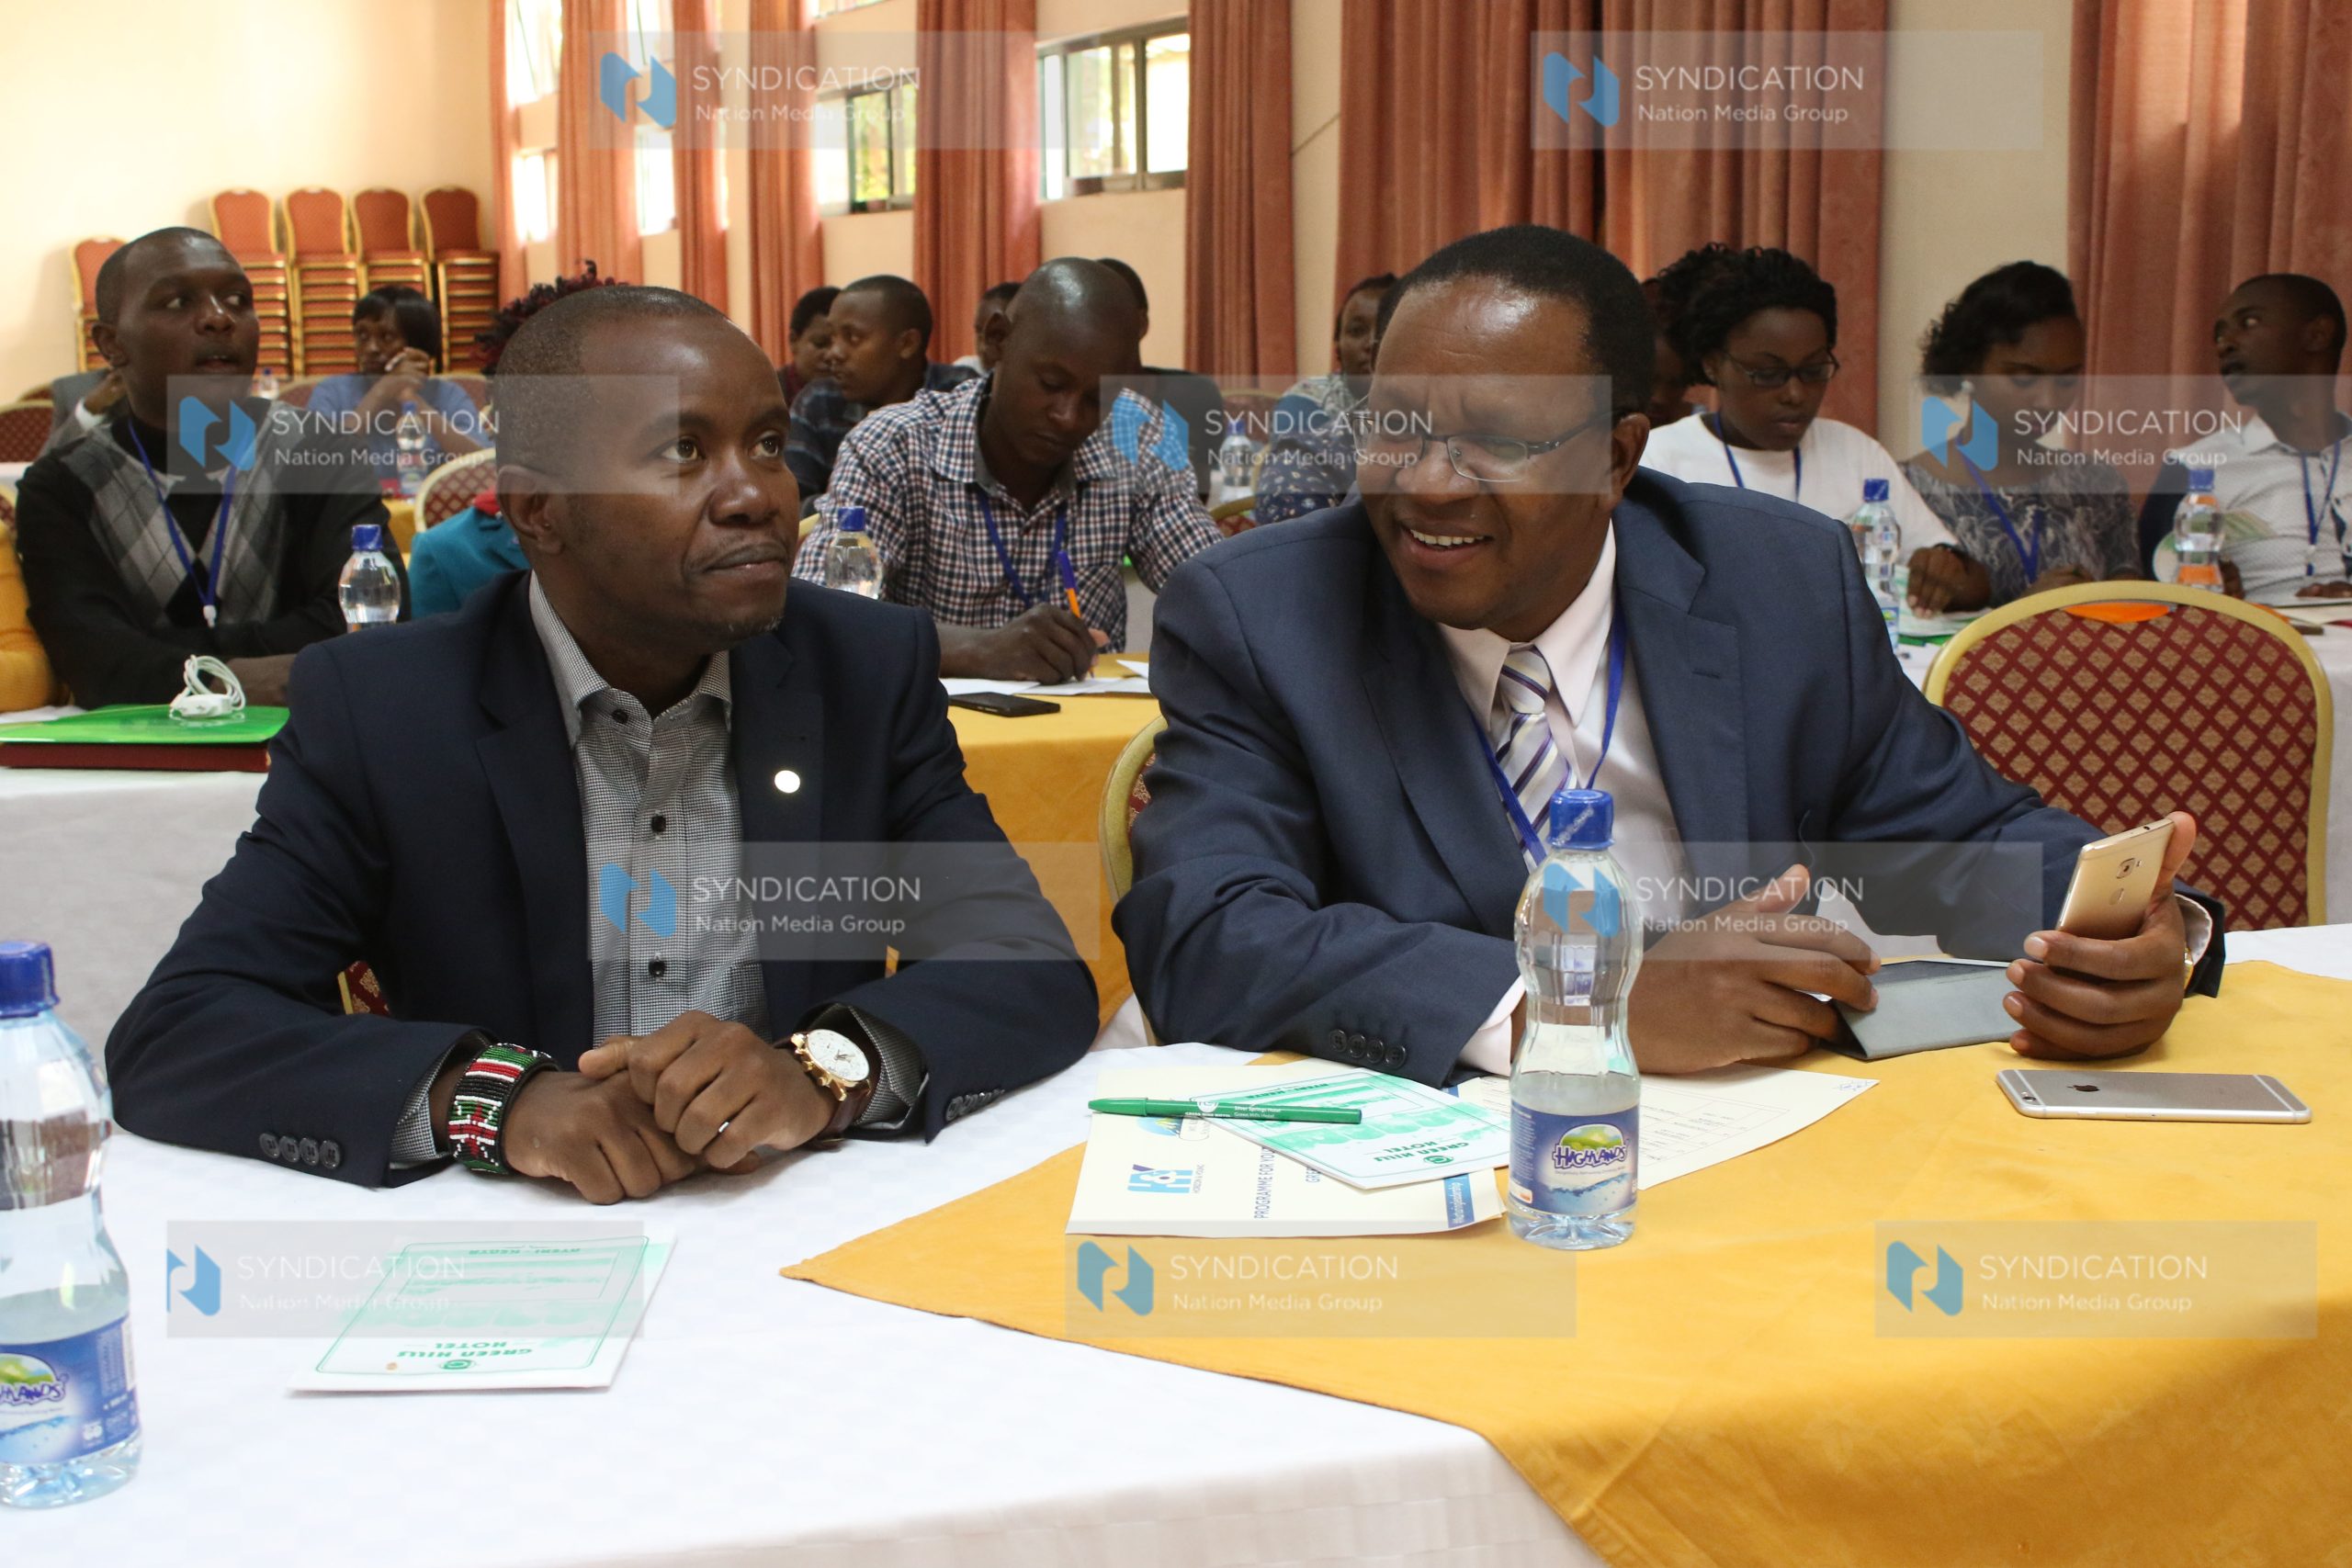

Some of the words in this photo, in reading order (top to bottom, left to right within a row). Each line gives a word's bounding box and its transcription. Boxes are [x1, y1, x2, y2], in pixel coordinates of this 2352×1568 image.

[1384, 1141, 1438, 1153] HOTEL
[1419, 1142, 1469, 1156] GREEN
[1553, 1145, 1626, 1168] HIGHLANDS
[1259, 1164, 1273, 1176] FOR
[1254, 1176, 1272, 1219] PROGRAMME
[435, 1341, 507, 1349] HOTEL
[460, 1348, 533, 1358] GREEN
